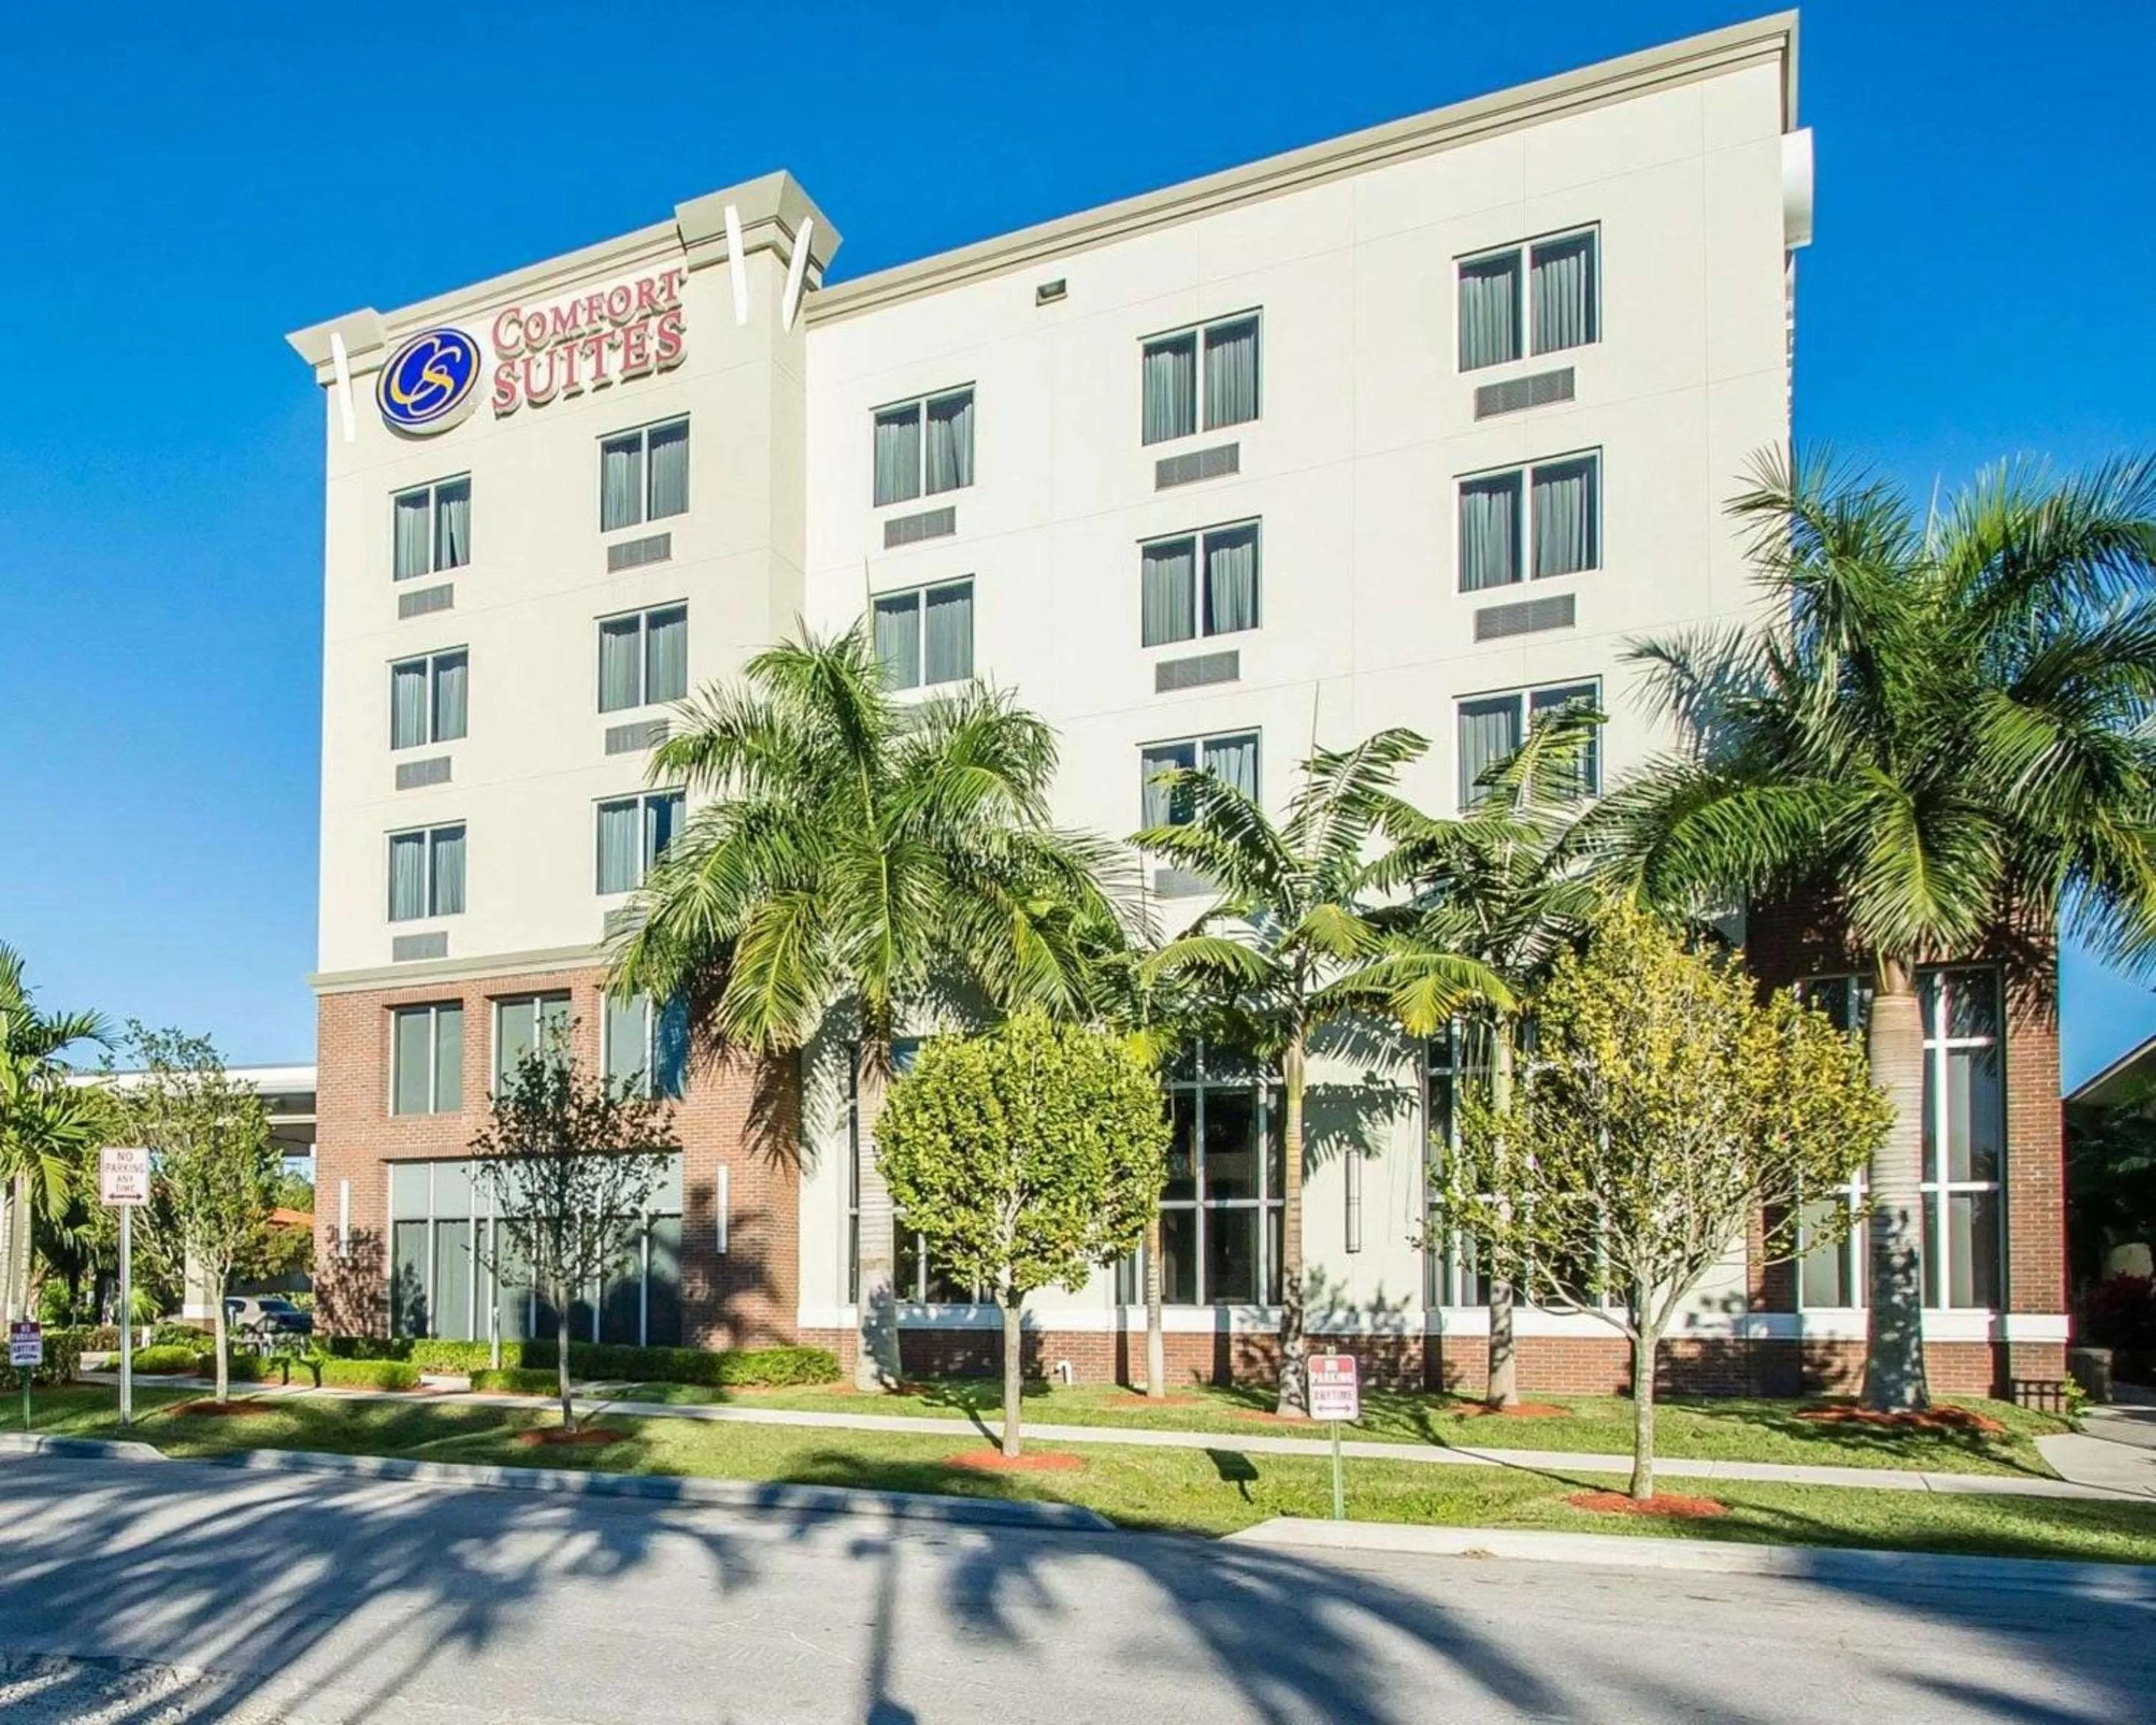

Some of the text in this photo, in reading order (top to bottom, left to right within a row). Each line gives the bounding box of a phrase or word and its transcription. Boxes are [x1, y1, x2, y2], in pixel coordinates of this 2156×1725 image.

[492, 267, 683, 352] COMFORT
[492, 308, 683, 410] SUITES
[106, 1162, 145, 1174] PARKING
[117, 1151, 134, 1162] NO
